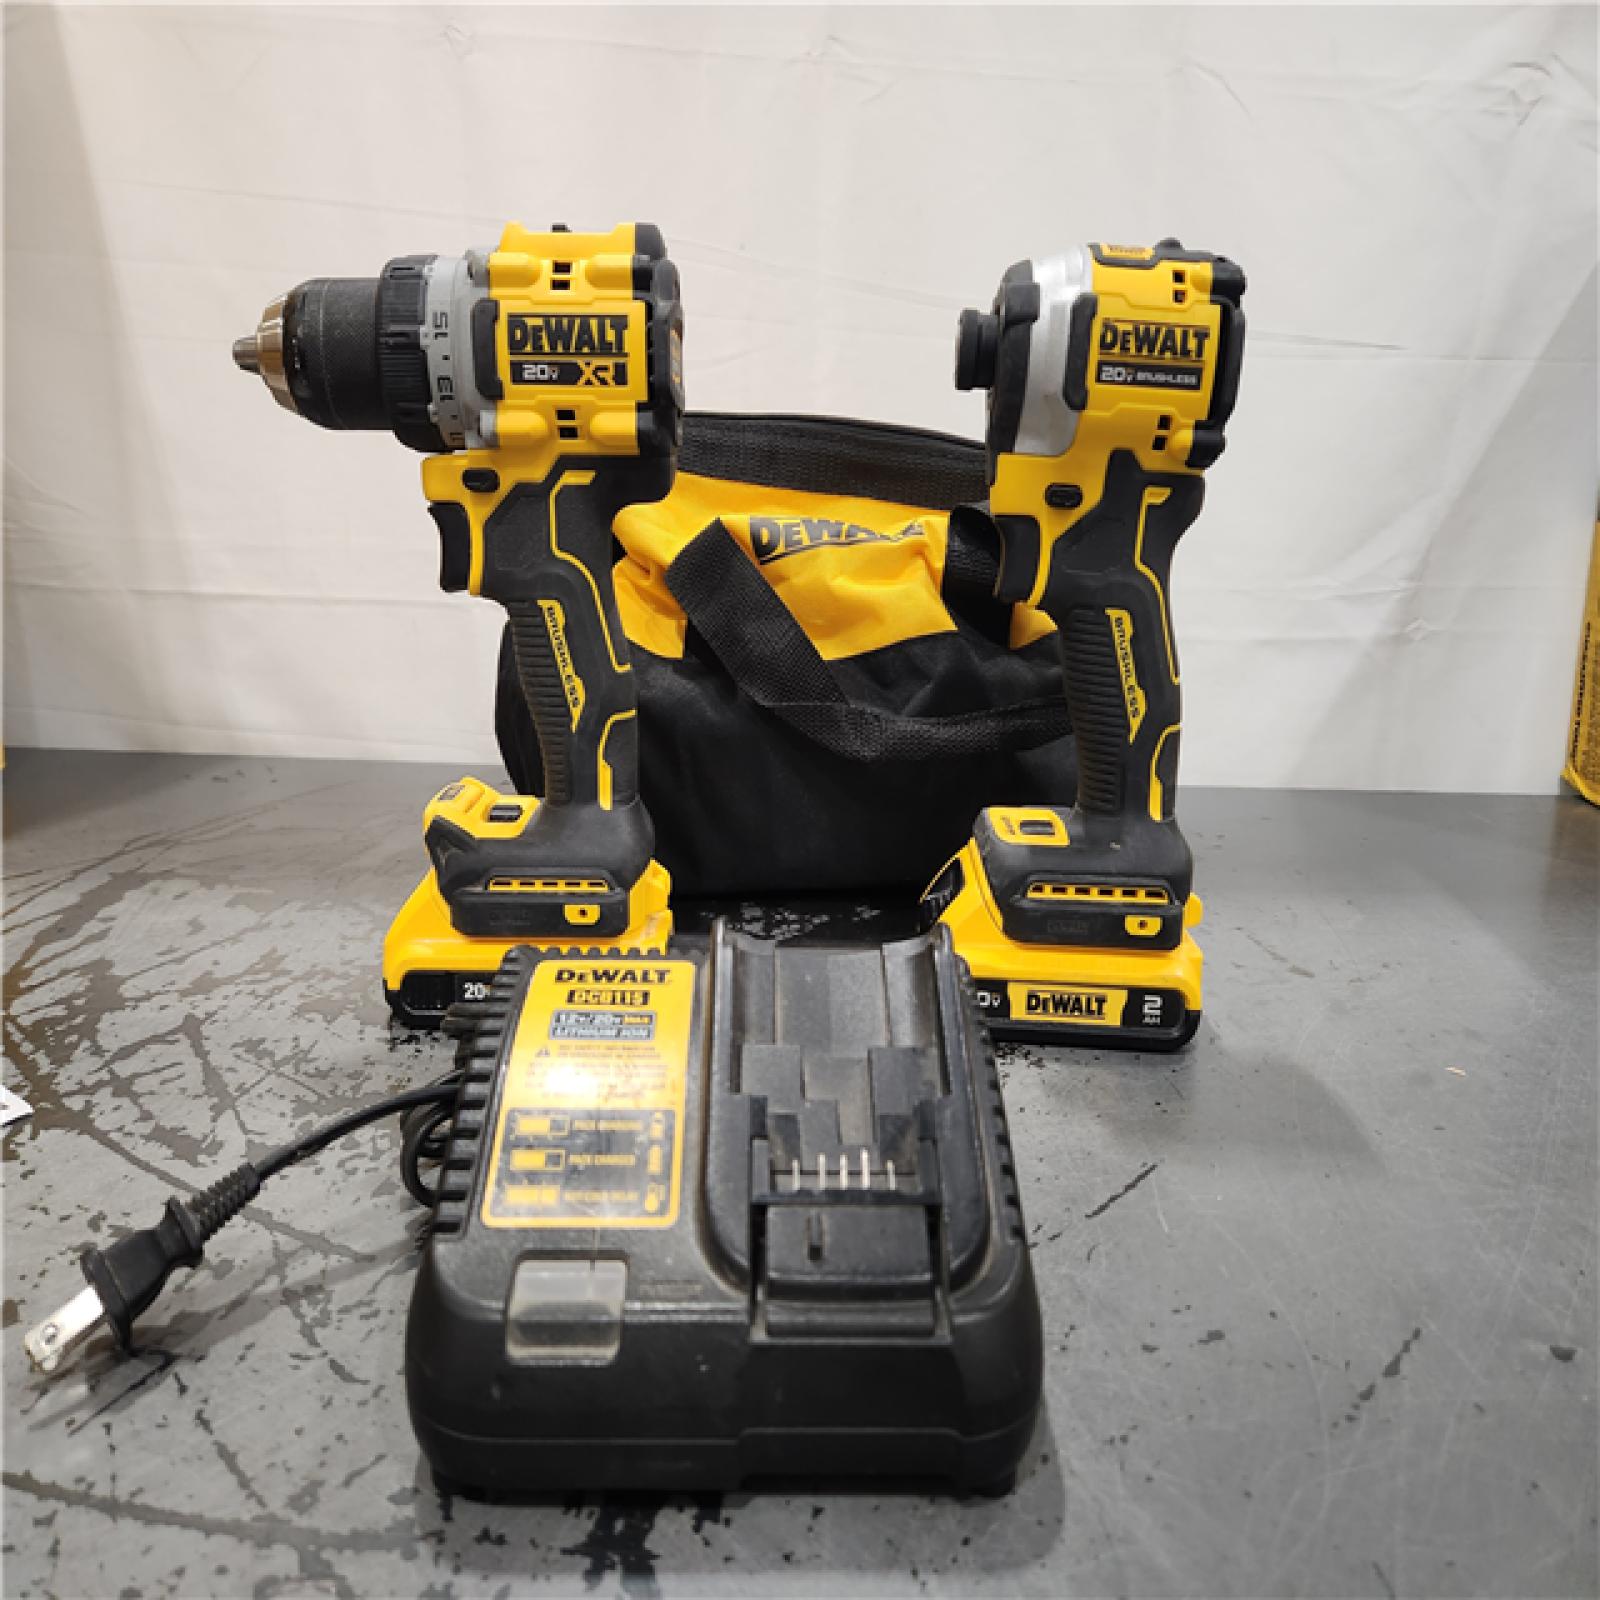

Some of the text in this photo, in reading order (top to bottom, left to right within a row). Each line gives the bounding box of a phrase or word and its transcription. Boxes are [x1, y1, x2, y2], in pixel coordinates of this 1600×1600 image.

[432, 311, 449, 341] 15
[508, 316, 628, 353] DEWALT
[1099, 322, 1210, 359] DEWALT
[555, 969, 671, 983] DEWALT
[1026, 991, 1107, 1018] DEWALT
